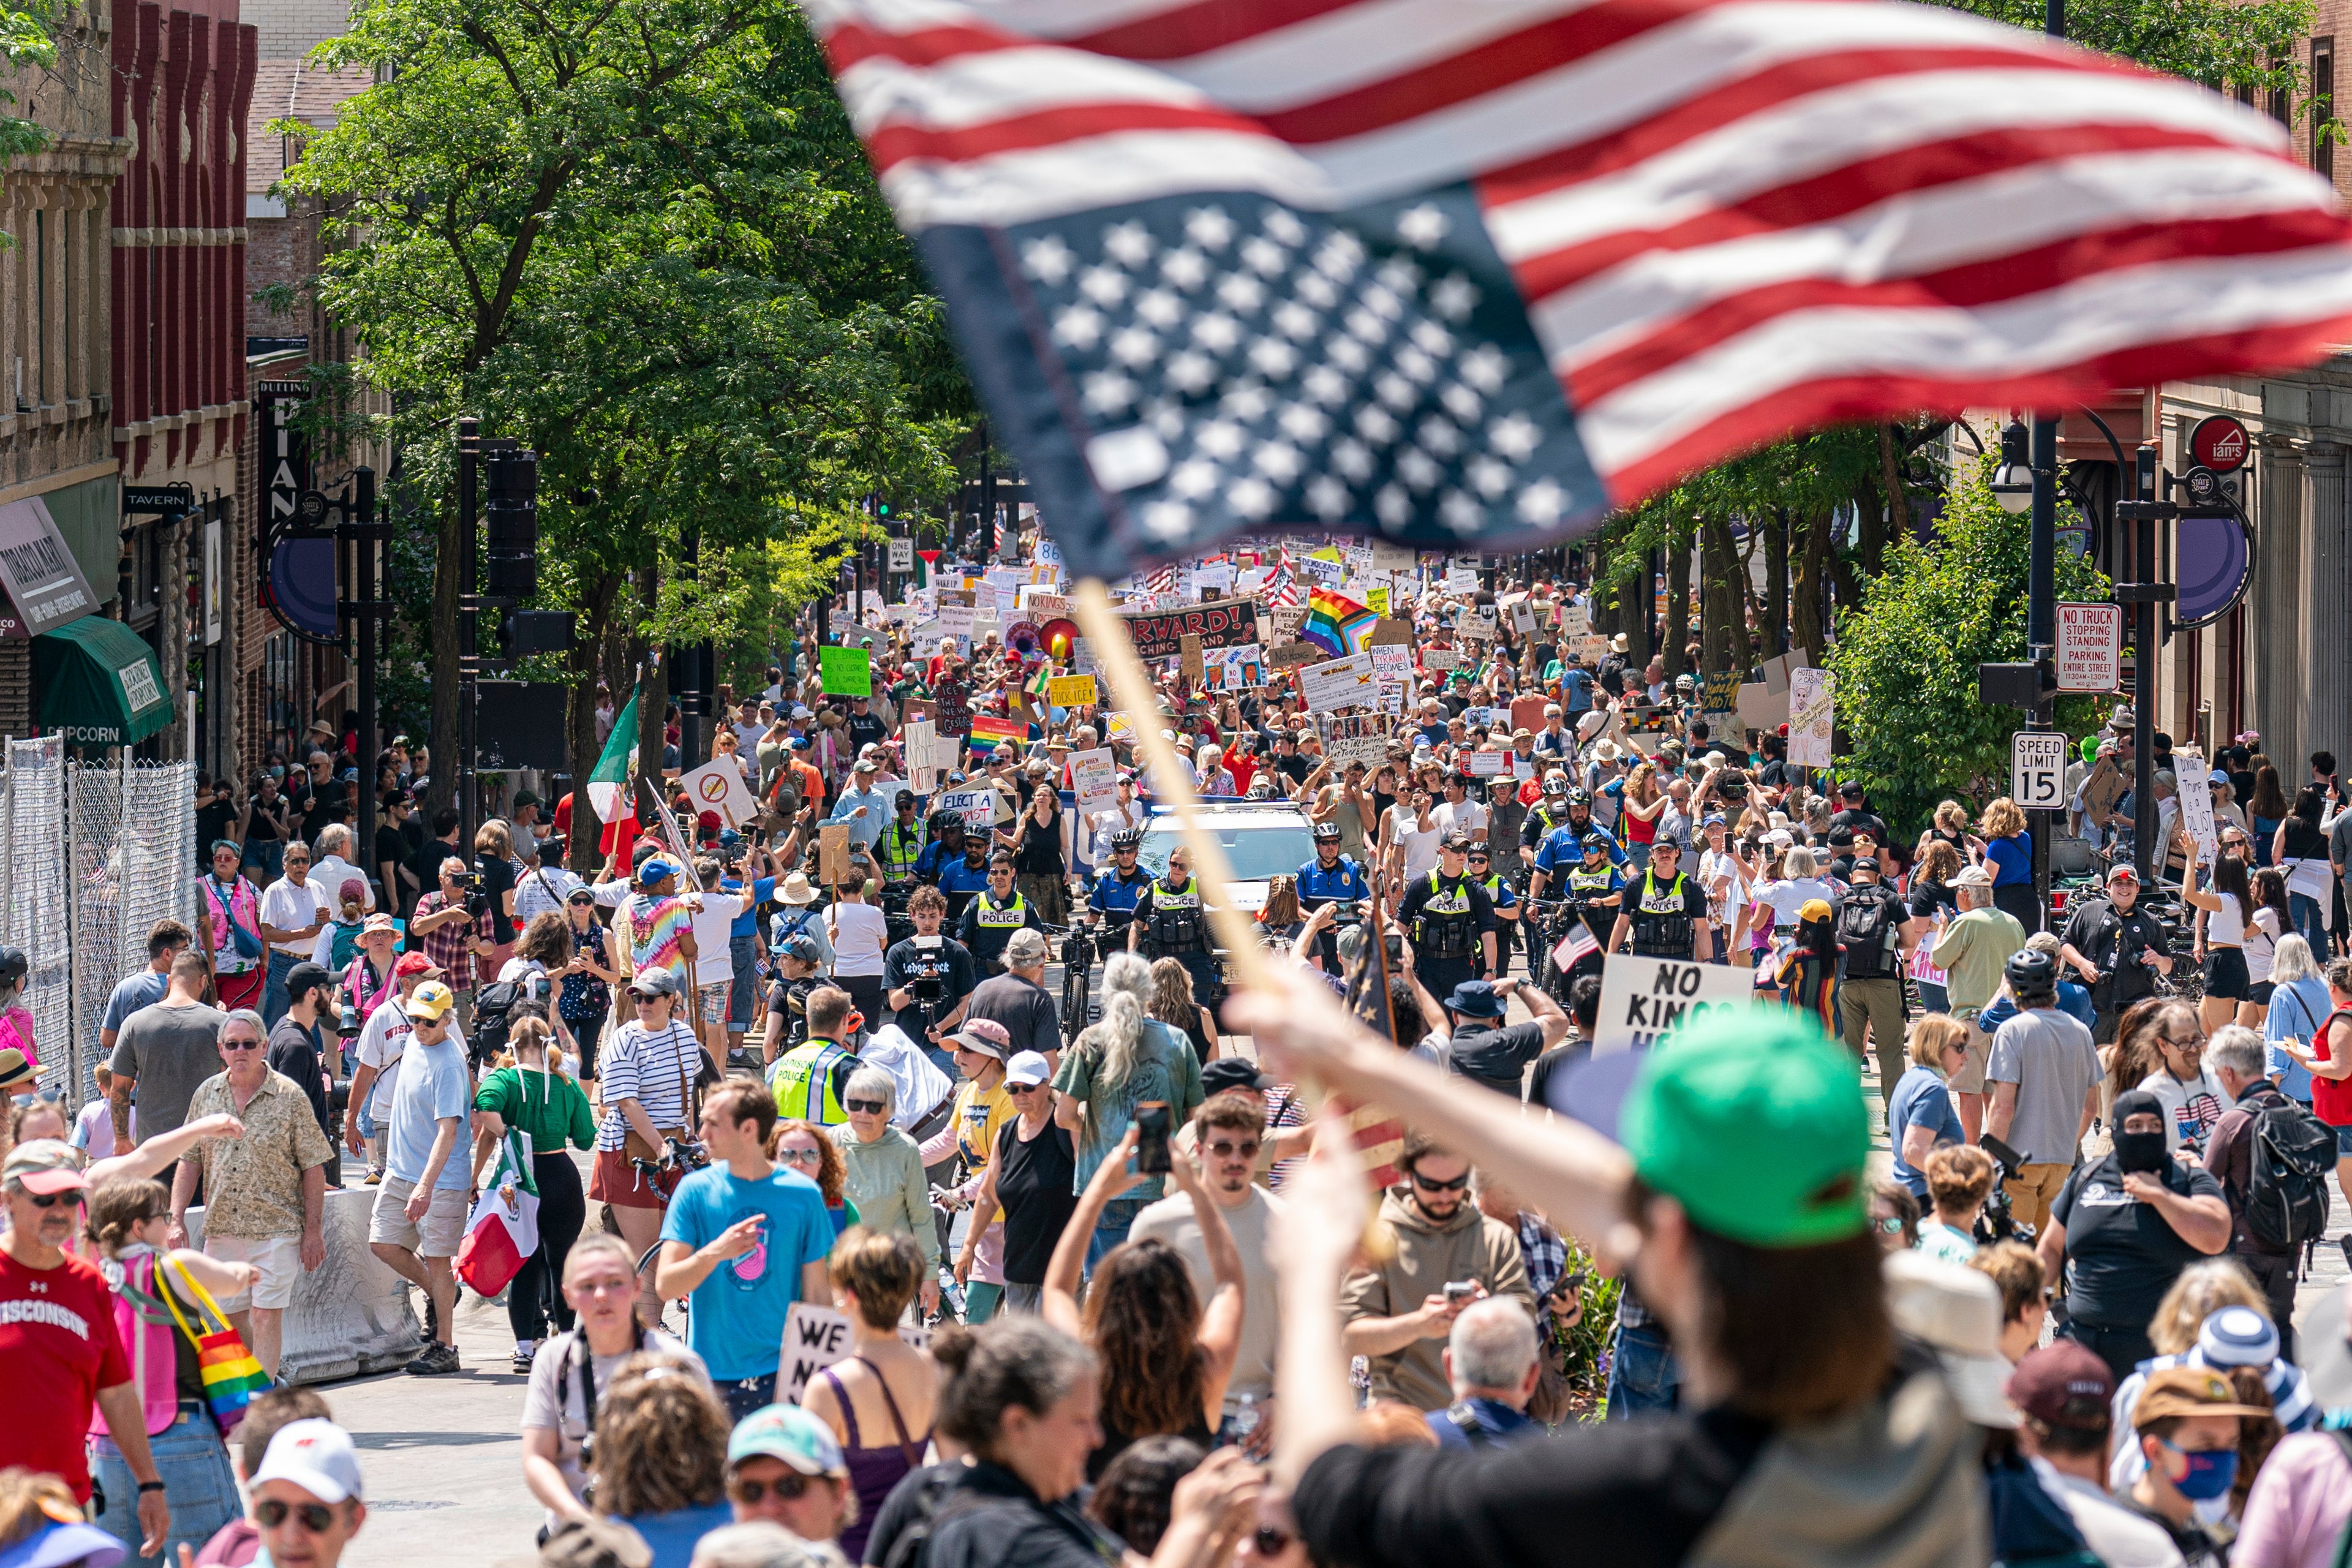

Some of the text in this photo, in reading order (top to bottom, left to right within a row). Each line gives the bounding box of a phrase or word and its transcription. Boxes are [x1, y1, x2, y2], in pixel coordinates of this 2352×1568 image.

[260, 383, 309, 393] DUELING
[2213, 443, 2242, 457] ian's
[2192, 478, 2209, 486] STATE
[127, 495, 184, 507] TAVERN
[1042, 544, 1060, 560] 86
[1349, 546, 1372, 559] DOGE
[1302, 558, 1341, 573] DEMOCRACY
[1308, 568, 1329, 579] NOT
[1028, 595, 1066, 610] NO KINGS
[1027, 611, 1039, 624] NO
[2064, 609, 2113, 624] NO TRUCK
[1117, 605, 1242, 643] ORWARD!
[2066, 625, 2111, 635] STOPPING
[1275, 627, 1300, 636] PROCE
[1132, 635, 1224, 655] RCHING AND
[1572, 636, 1607, 646] NO KINGS
[2066, 636, 2109, 647] STANDING
[1204, 651, 1215, 661] NO
[1372, 646, 1393, 655] WHEN
[2069, 651, 2106, 661] PARKING
[1374, 652, 1406, 664] TYRANNY
[1376, 662, 1408, 673] BECOMES
[2064, 663, 2111, 672] ENTIRE STREET
[125, 661, 151, 690] GOURMET
[1227, 677, 1240, 686] KINGS
[1378, 671, 1395, 680] LAW
[1804, 676, 1824, 685] CASINO
[131, 680, 157, 707] POPCORN
[1051, 690, 1092, 704] FUCK ICE!
[941, 698, 956, 706] THE
[942, 707, 967, 716] NEW
[1797, 710, 1811, 723] course
[1817, 703, 1831, 719] period
[1703, 713, 1717, 722] E'RE
[944, 718, 971, 733] GESTAPO
[2018, 740, 2060, 754] SPEED
[1085, 756, 1099, 766] WHEN
[1087, 762, 1110, 772] INJUSTICE
[2022, 755, 2056, 768] LIMIT
[2180, 758, 2198, 772] Donald
[911, 767, 922, 791] NO
[1090, 781, 1118, 791] RESISTANCE
[2022, 771, 2056, 801] 15
[2182, 779, 2202, 794] Trump
[944, 792, 991, 809] ELECT A
[2195, 798, 2200, 807] a
[1158, 897, 1195, 907] POLICE
[1645, 900, 1678, 912] POLICE
[982, 914, 1020, 924] POLICE
[1229, 968, 1242, 979] E9
[1654, 963, 1702, 997] NO
[778, 1058, 813, 1070] MADISON
[777, 1070, 805, 1083] POLICE
[0, 1298, 90, 1341] ISCONSIN
[797, 1316, 846, 1353] WE
